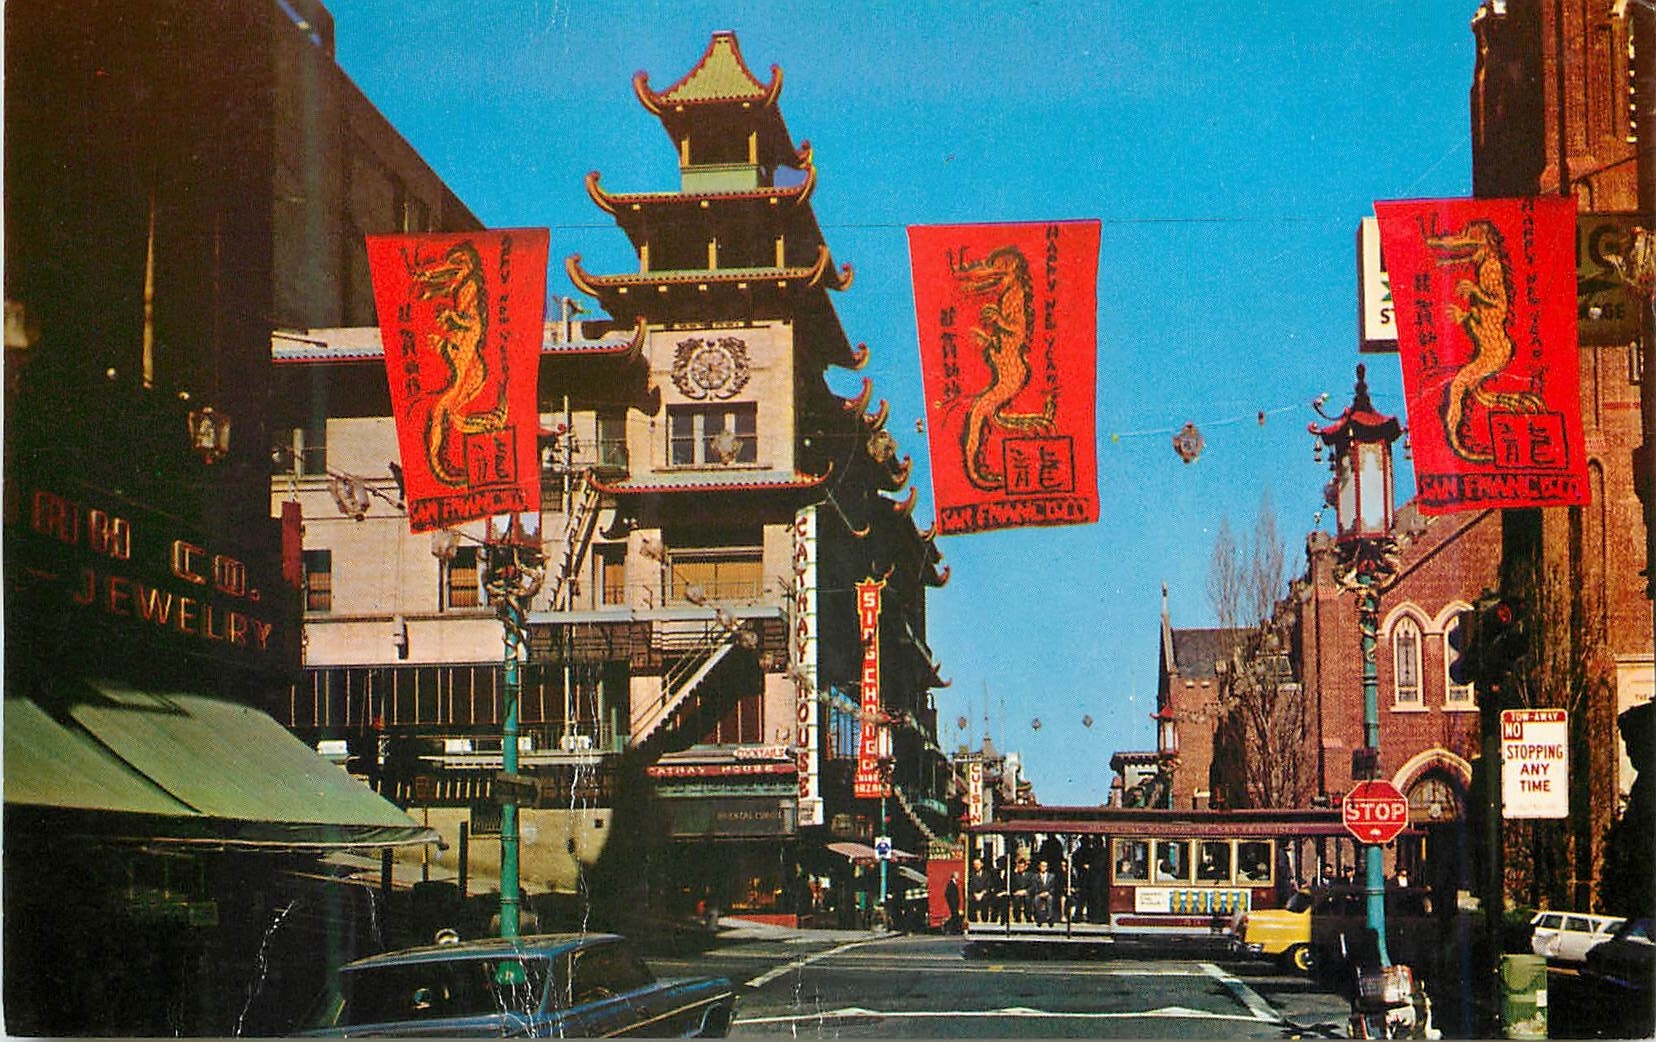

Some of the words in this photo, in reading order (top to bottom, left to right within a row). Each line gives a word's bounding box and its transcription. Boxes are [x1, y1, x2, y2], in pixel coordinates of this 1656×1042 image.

[1521, 200, 1535, 265] HAPPY
[1045, 224, 1058, 293] HAPPY
[1526, 272, 1540, 306] NEW
[1044, 299, 1057, 331] NEW
[1529, 310, 1543, 360] YEAR
[1044, 337, 1058, 384] YEAR
[1421, 477, 1457, 500] SAN
[1465, 475, 1579, 499] FRANCISCO
[411, 499, 438, 525] SAN
[943, 505, 973, 531] SAN
[977, 498, 1088, 527] FRANCISCO
[795, 516, 808, 663] CATHAY
[75, 568, 272, 648] JEWELRY
[1505, 722, 1522, 738] NO
[1511, 712, 1558, 722] TOW-AWAY
[1507, 744, 1563, 760] STOPPING
[649, 766, 705, 774] CATHAY
[721, 764, 774, 774] HOUSE
[1520, 763, 1549, 775] ANY
[1520, 780, 1551, 792] TIME
[1346, 803, 1405, 821] STOP
